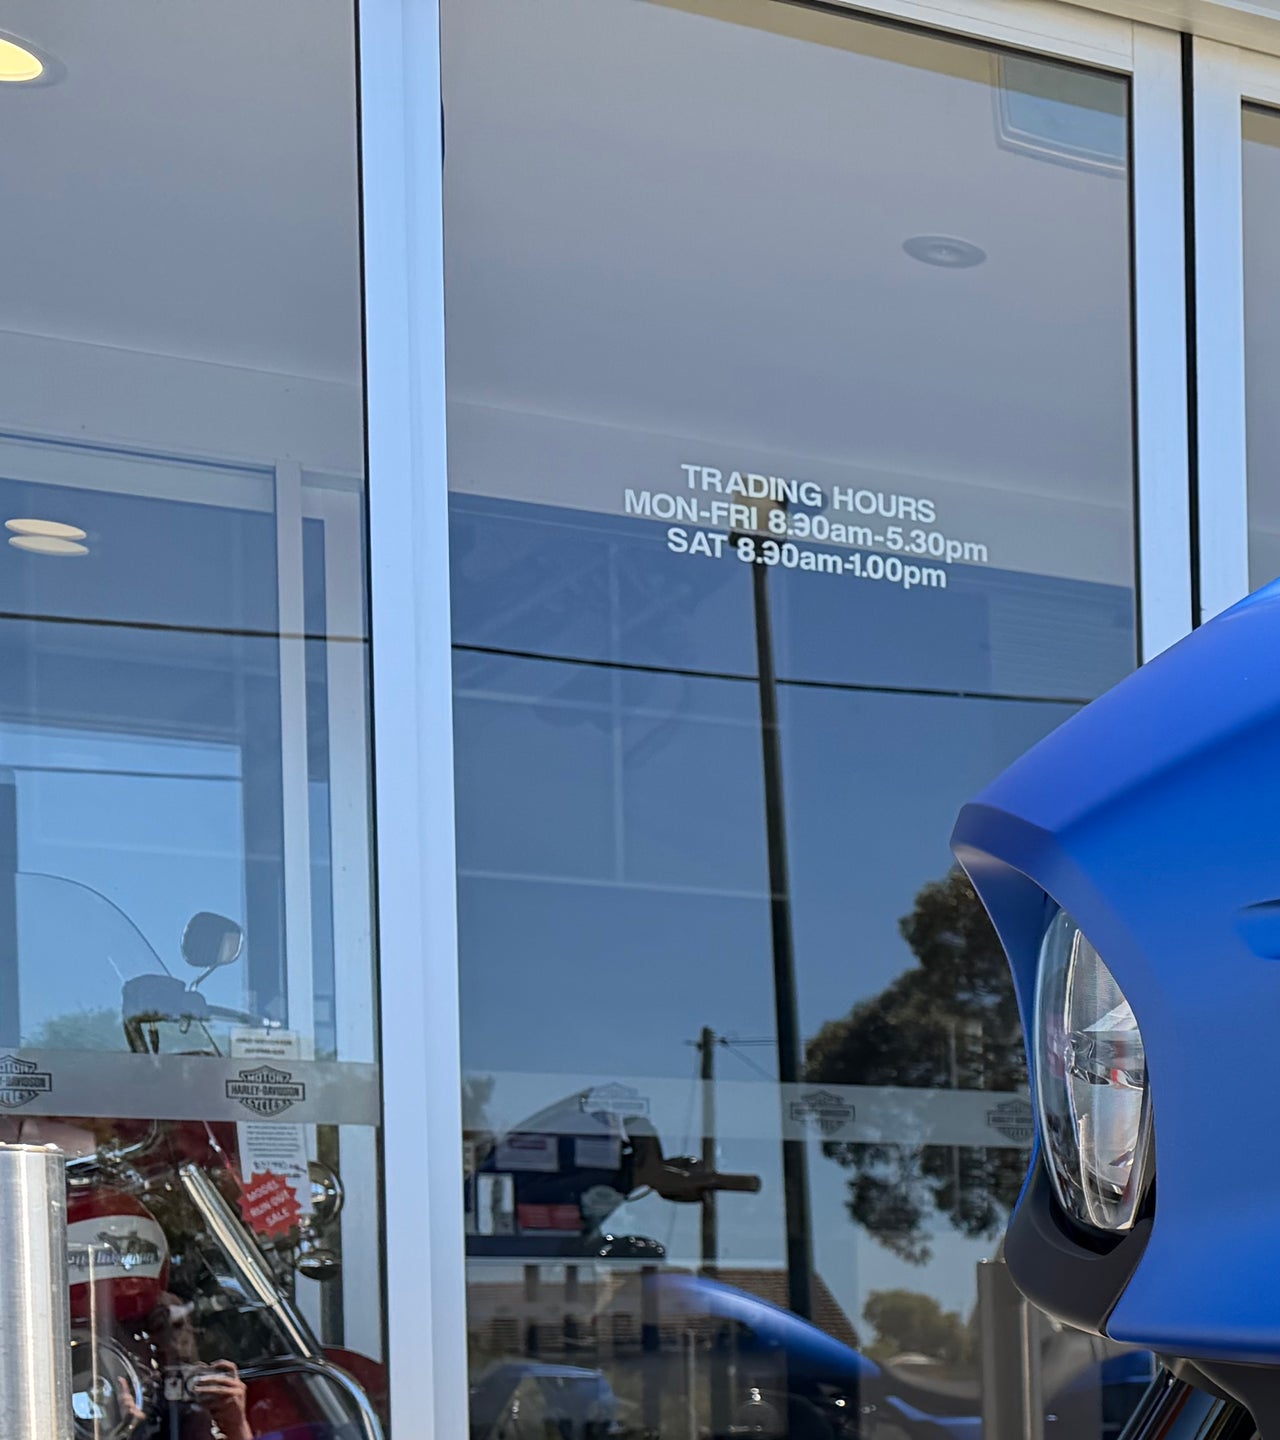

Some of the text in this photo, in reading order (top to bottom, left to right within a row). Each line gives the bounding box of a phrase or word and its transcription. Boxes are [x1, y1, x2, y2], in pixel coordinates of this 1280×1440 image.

[681, 464, 936, 524] TRADING HOURS
[623, 489, 989, 563] MON-FRI 8.30am-5.30pm
[667, 528, 947, 589] SAT 8.30am-1.00pm
